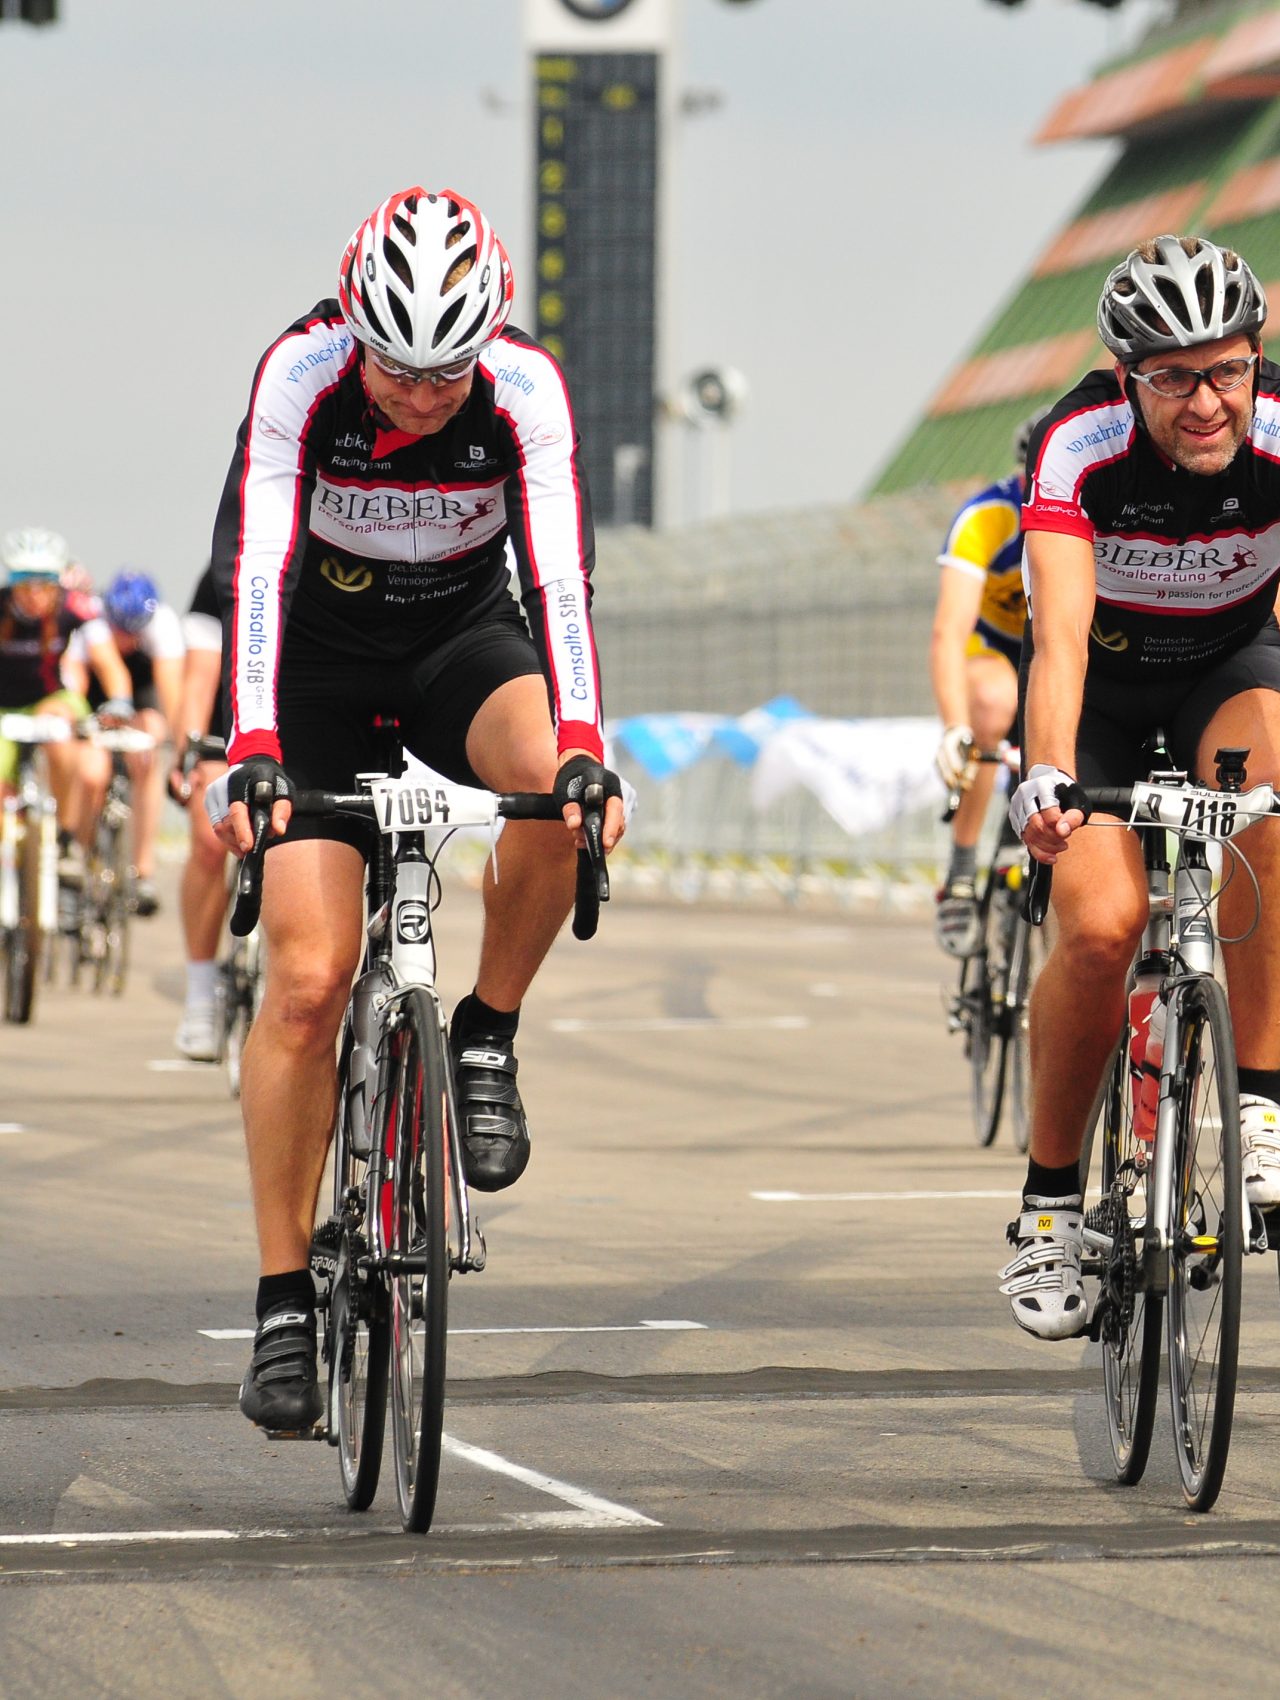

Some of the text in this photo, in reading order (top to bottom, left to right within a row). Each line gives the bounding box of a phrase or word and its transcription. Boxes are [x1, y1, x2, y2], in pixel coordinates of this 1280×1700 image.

[370, 335, 388, 352] uvex
[454, 345, 473, 359] uvex
[319, 486, 467, 522] BIEBER
[318, 506, 447, 534] personalberatung
[1094, 540, 1228, 571] BIEBER
[558, 593, 578, 618] StB
[1168, 589, 1205, 600] passion
[1208, 591, 1222, 600] for
[248, 576, 269, 655] Consalto
[247, 659, 265, 684] StB
[563, 622, 588, 701] Consalto
[380, 788, 450, 827] 7094
[1180, 797, 1237, 838] 7118
